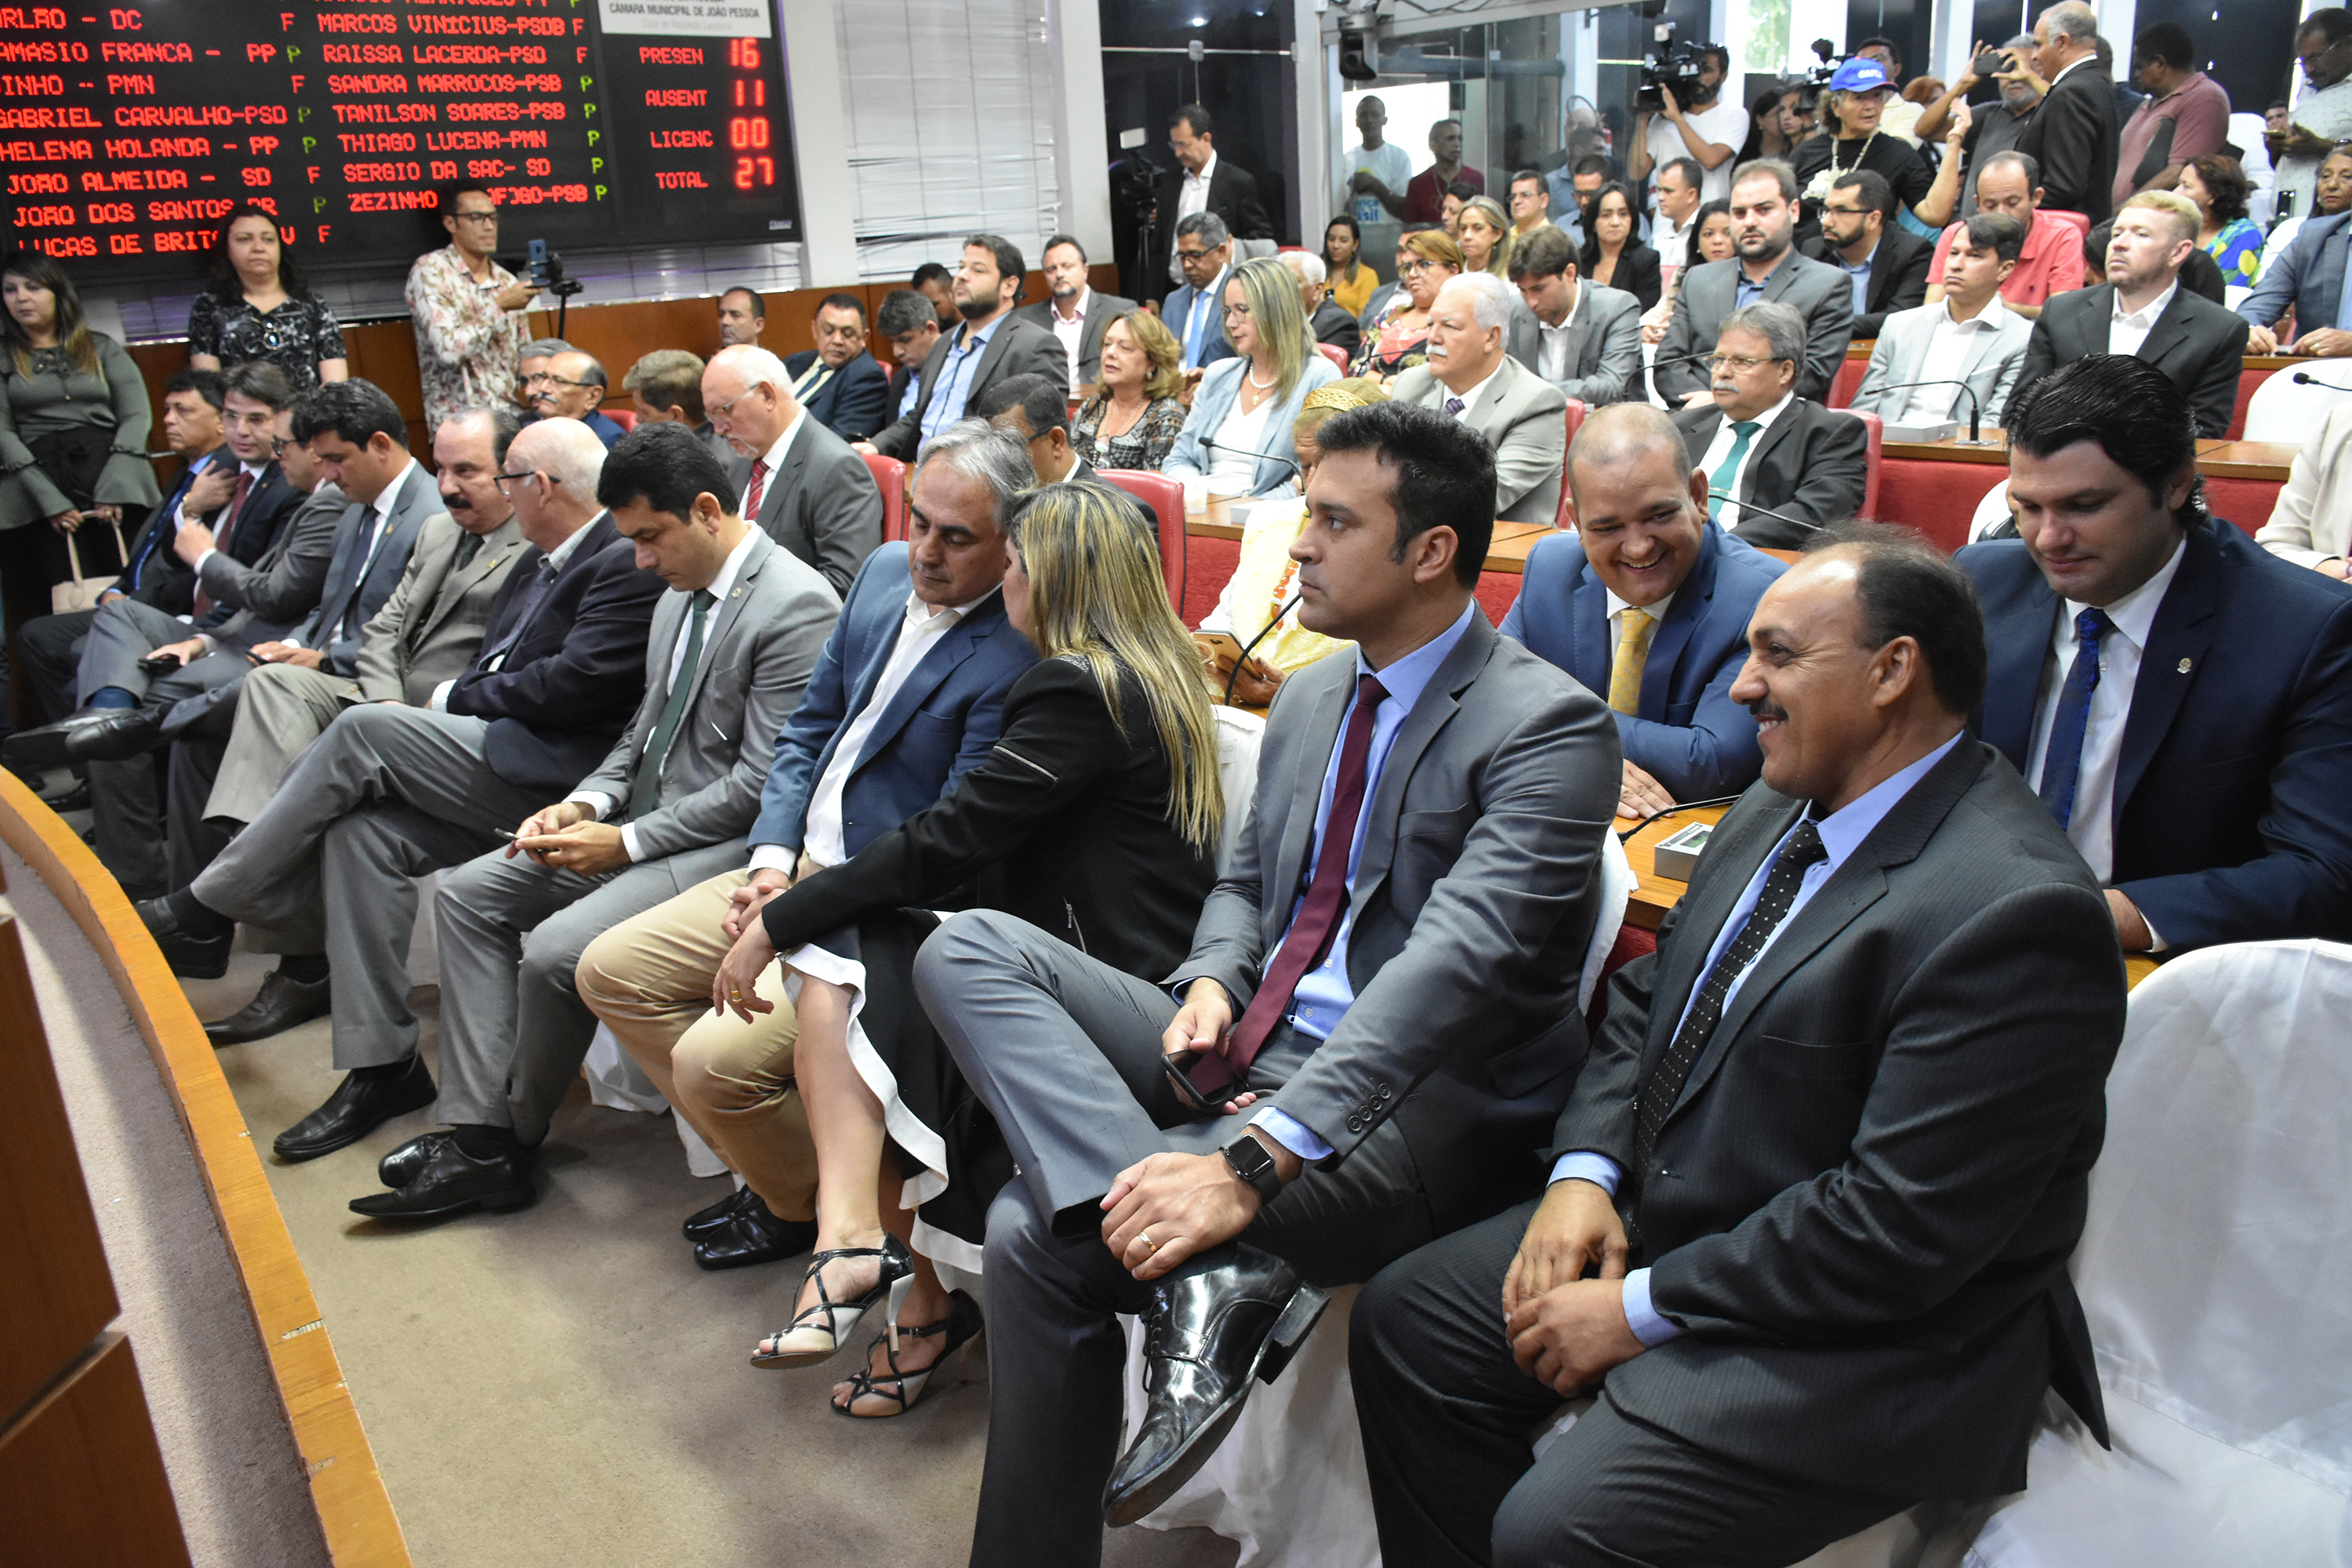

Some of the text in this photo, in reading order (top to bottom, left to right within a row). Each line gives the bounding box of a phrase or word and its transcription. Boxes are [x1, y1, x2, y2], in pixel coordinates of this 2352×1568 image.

[110, 9, 142, 30] DC
[281, 13, 294, 31] F
[647, 4, 691, 16] MUNICIPAL
[693, 5, 704, 16] DE
[728, 6, 760, 18] PESSOA
[318, 13, 397, 33] MARCOS
[572, 18, 584, 35] F
[102, 42, 193, 62] FRANCA
[247, 44, 277, 63] PP
[287, 45, 301, 63] P
[323, 45, 587, 64] RAISSA LACERDA-PSD F
[640, 37, 760, 68] PRESEN 16
[0, 74, 64, 96] INHO
[107, 74, 154, 94] PMN
[292, 75, 305, 93] F
[328, 74, 593, 93] SANDRA MARROCOS-PSB P
[645, 79, 764, 107] AUSENT 11
[115, 106, 288, 126] CARVALHO-PSD
[298, 108, 310, 123] P
[332, 102, 596, 123] TANILSON SOARES-PSB P
[338, 130, 600, 152] THIAGO LUCENA-PMN P
[651, 117, 769, 149] LICENC 00
[0, 140, 93, 162] HELENA
[105, 137, 210, 158] HOLANDA
[249, 136, 279, 155] PP
[303, 136, 317, 153] P
[82, 169, 187, 191] ALMEIDA
[241, 167, 271, 186] SD
[307, 166, 320, 183] F
[343, 162, 421, 182] SERGIO
[430, 161, 457, 180] DA
[526, 158, 551, 176] SD
[591, 158, 604, 174] P
[655, 156, 774, 189] TOTAL 27
[348, 191, 438, 212] ZEZINHO
[595, 185, 608, 201] P
[89, 203, 136, 223] DOS
[148, 199, 234, 221] SANTOS
[314, 198, 326, 213] P
[110, 234, 143, 254] DE
[154, 230, 218, 252] BRIT
[318, 225, 330, 242] F
